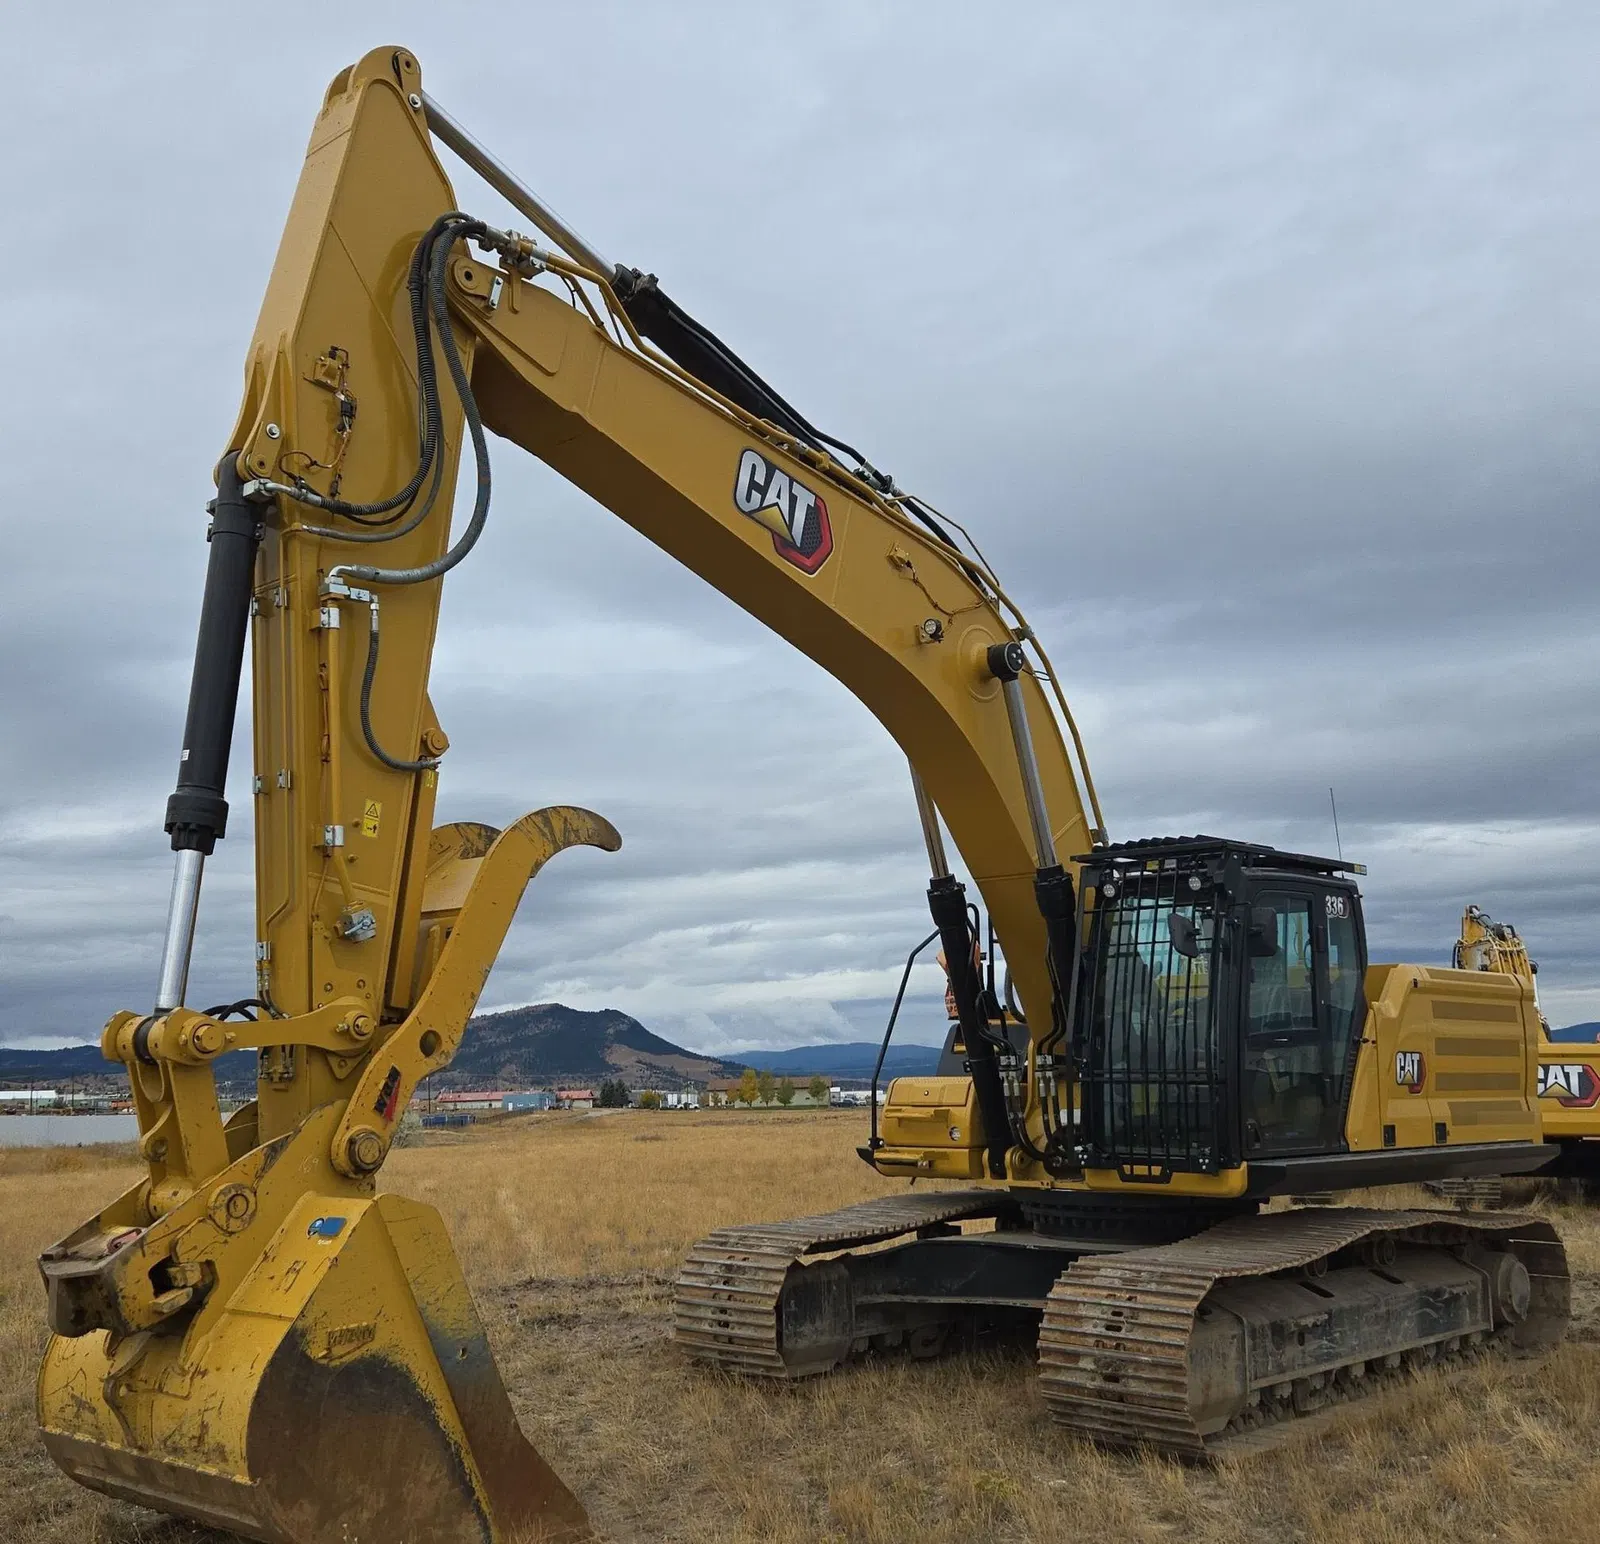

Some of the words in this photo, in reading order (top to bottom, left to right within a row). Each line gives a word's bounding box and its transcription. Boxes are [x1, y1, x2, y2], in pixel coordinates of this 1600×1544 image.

[736, 450, 816, 547] CAT
[1325, 895, 1343, 915] 336
[1396, 1052, 1420, 1084] CAT
